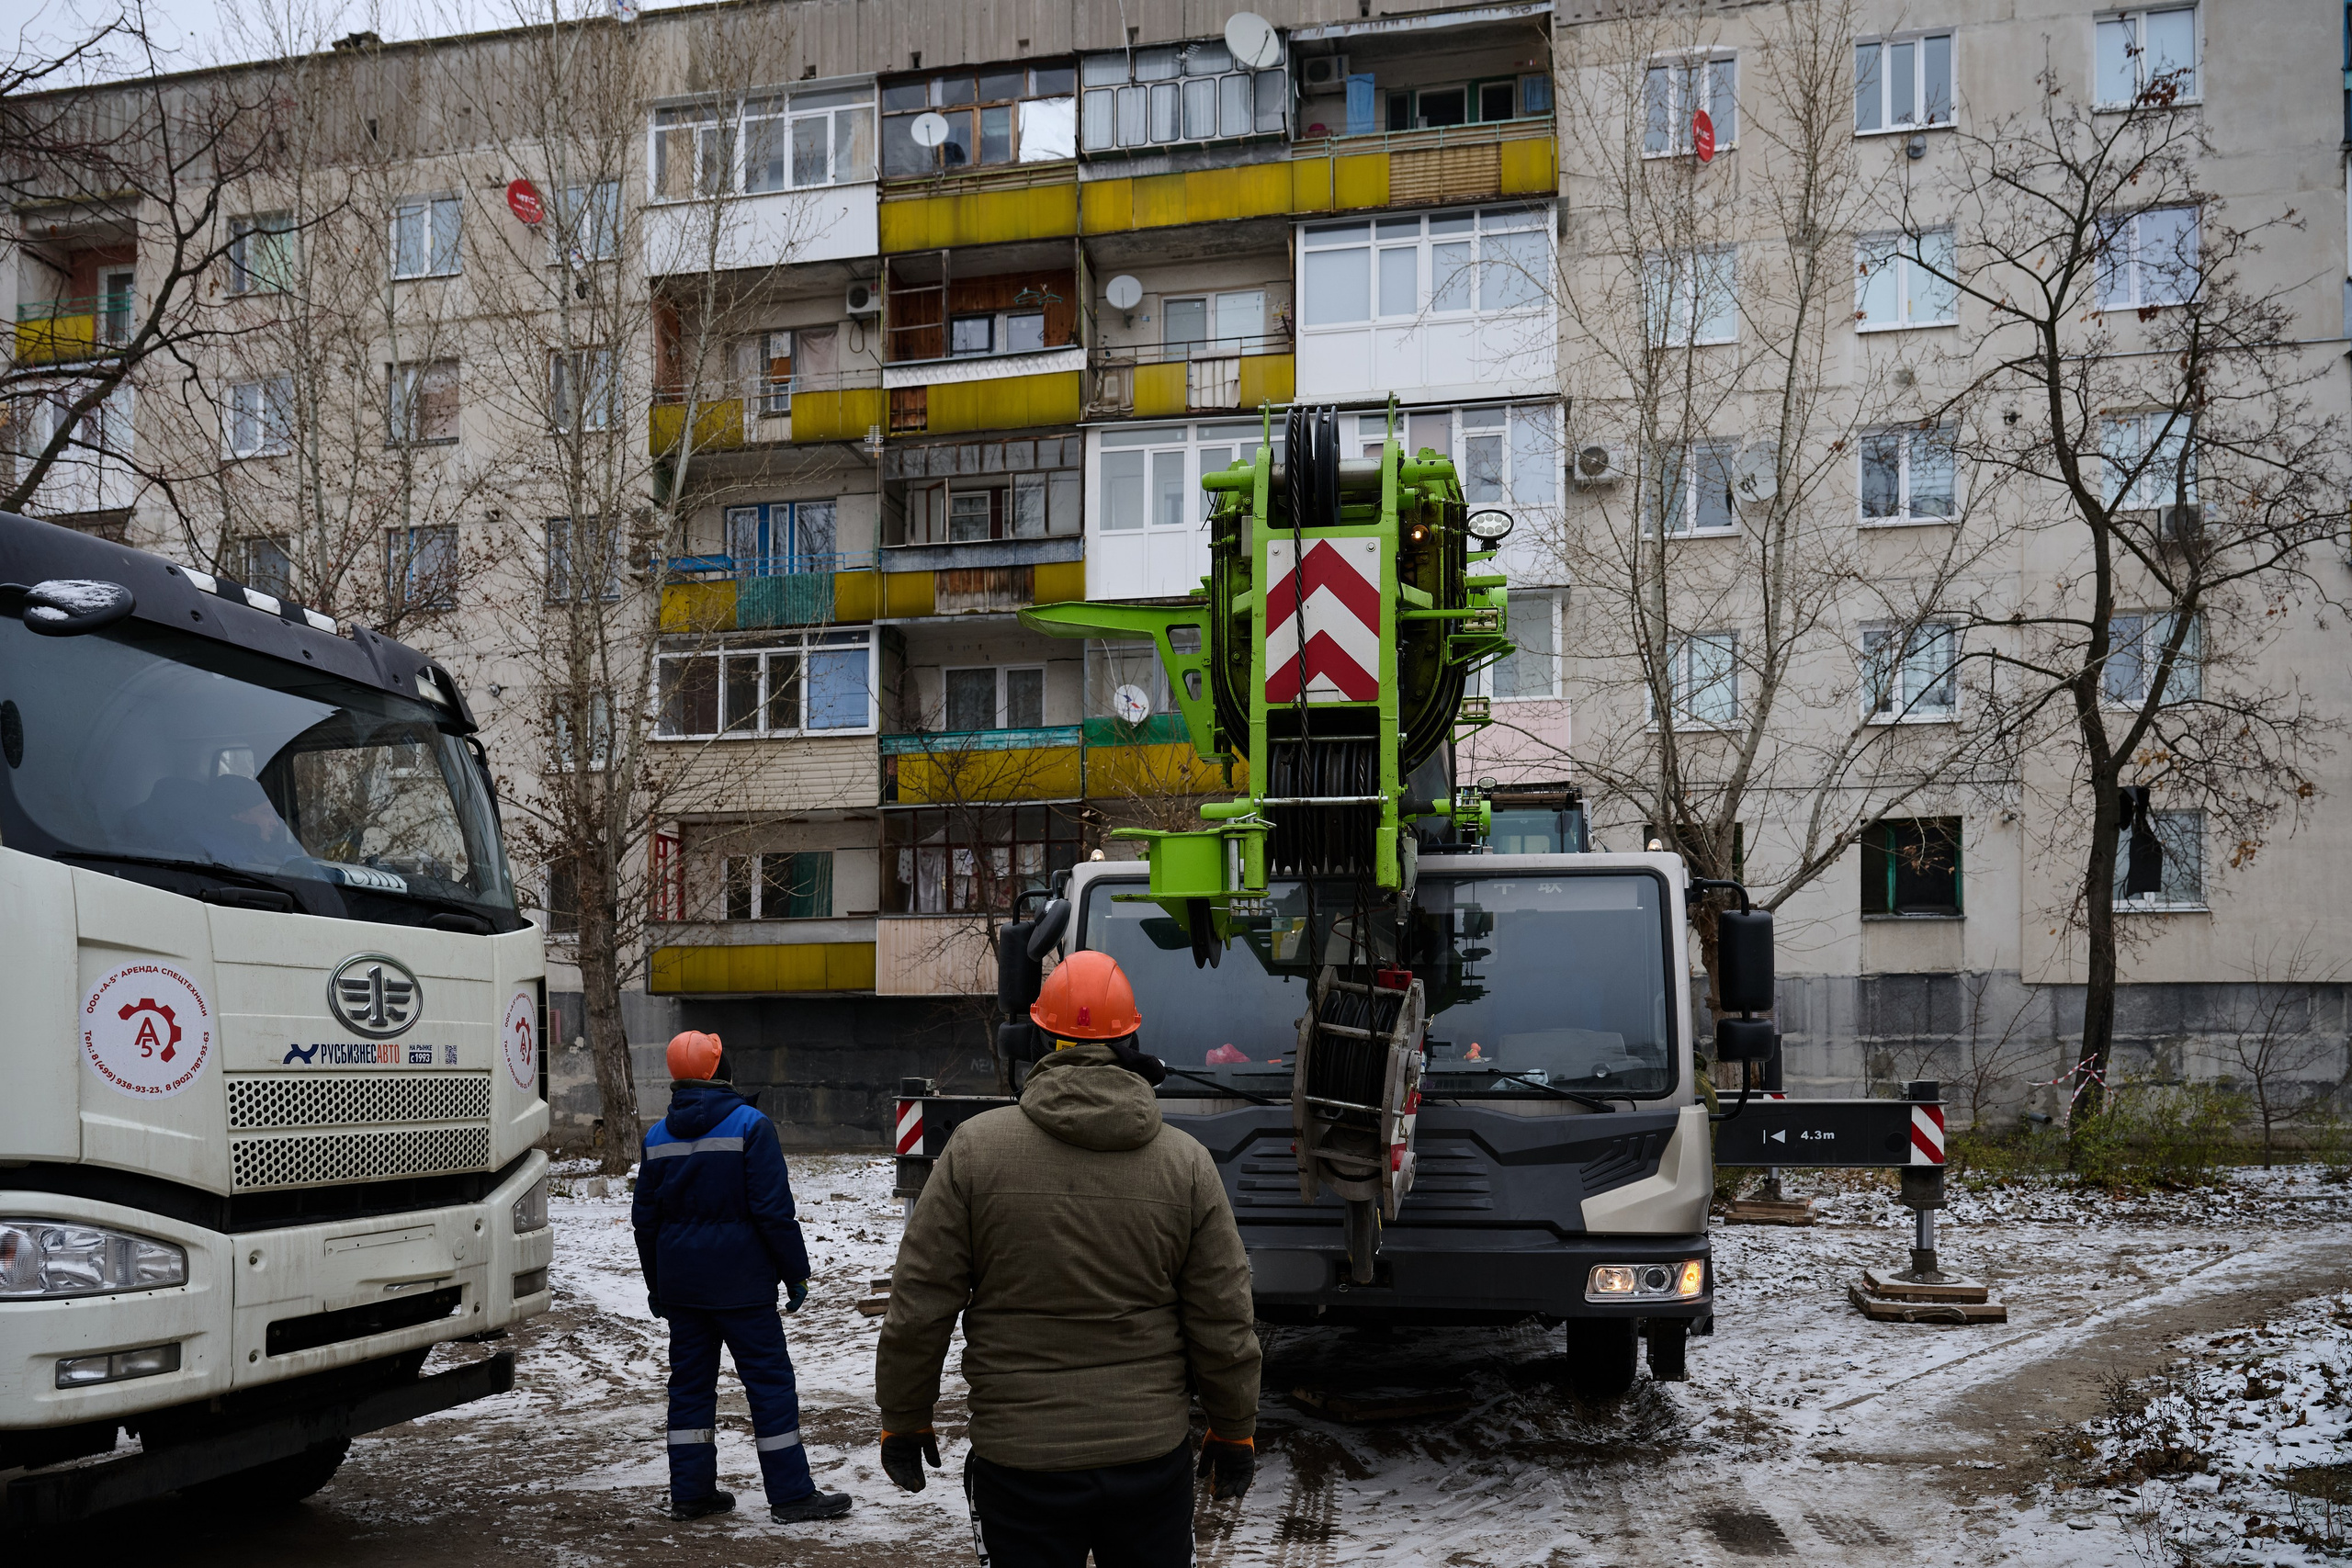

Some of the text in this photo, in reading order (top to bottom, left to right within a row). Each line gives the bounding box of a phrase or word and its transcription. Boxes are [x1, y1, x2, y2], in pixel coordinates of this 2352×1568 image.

[86, 993, 100, 1014] ООО
[120, 965, 159, 978] АРЕНДА
[161, 967, 208, 1017] СПЕЦТЕХНИКИ
[84, 1030, 209, 1094] Тел.: 8 (499) 938-93-23, 8 (902) 787-93-63
[322, 1043, 401, 1065] РУСБИЗНЕСАВТО
[414, 1053, 430, 1063] 1993
[1800, 1130, 1835, 1140] 4.3m
